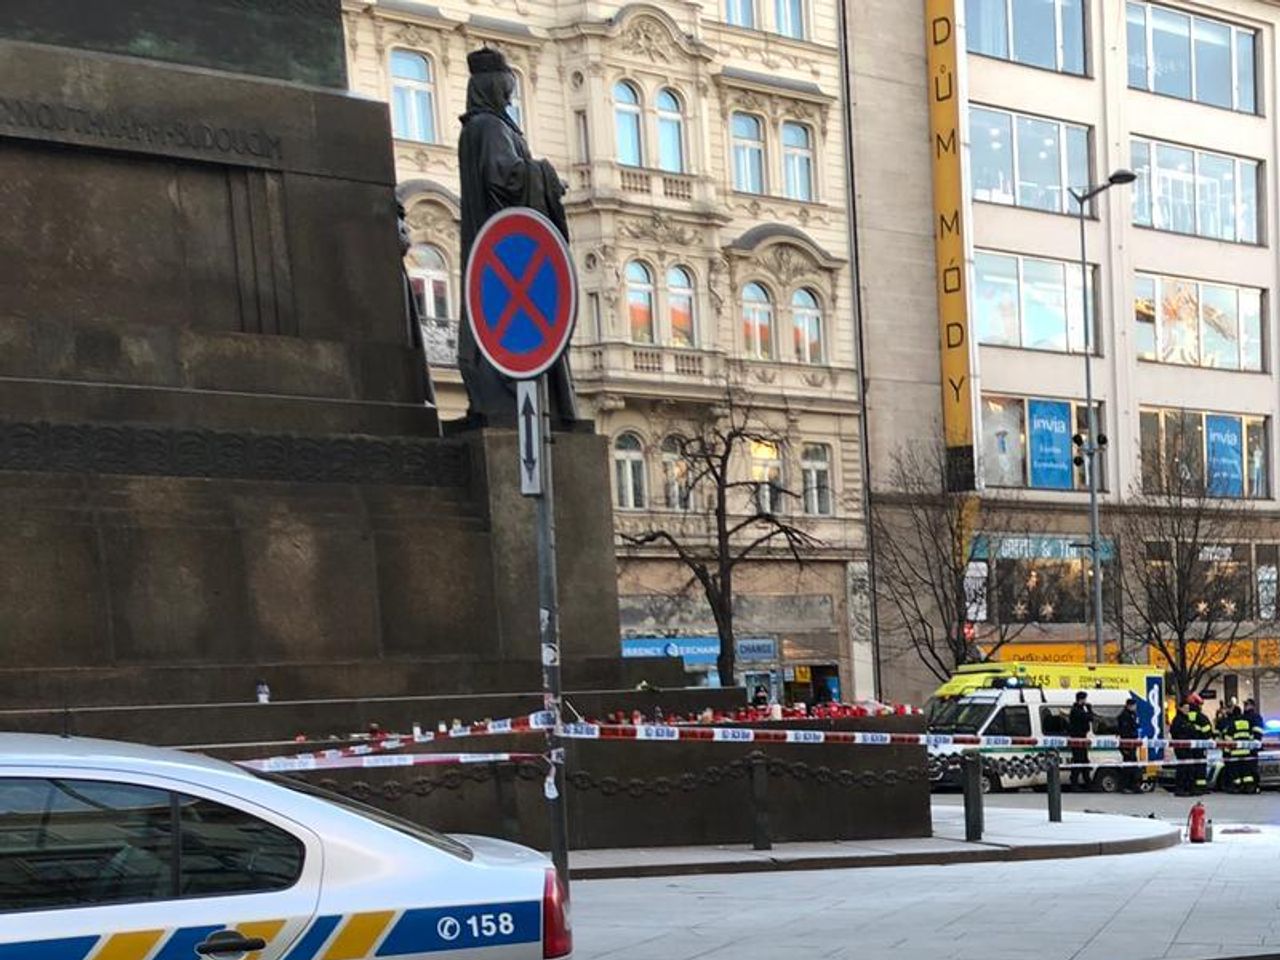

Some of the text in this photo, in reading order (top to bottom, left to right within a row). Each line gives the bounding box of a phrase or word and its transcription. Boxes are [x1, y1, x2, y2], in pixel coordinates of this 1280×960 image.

[932, 16, 965, 403] DŮM MÓDY
[1033, 413, 1067, 433] invia
[1209, 428, 1238, 446] invia
[466, 912, 515, 938] 158
